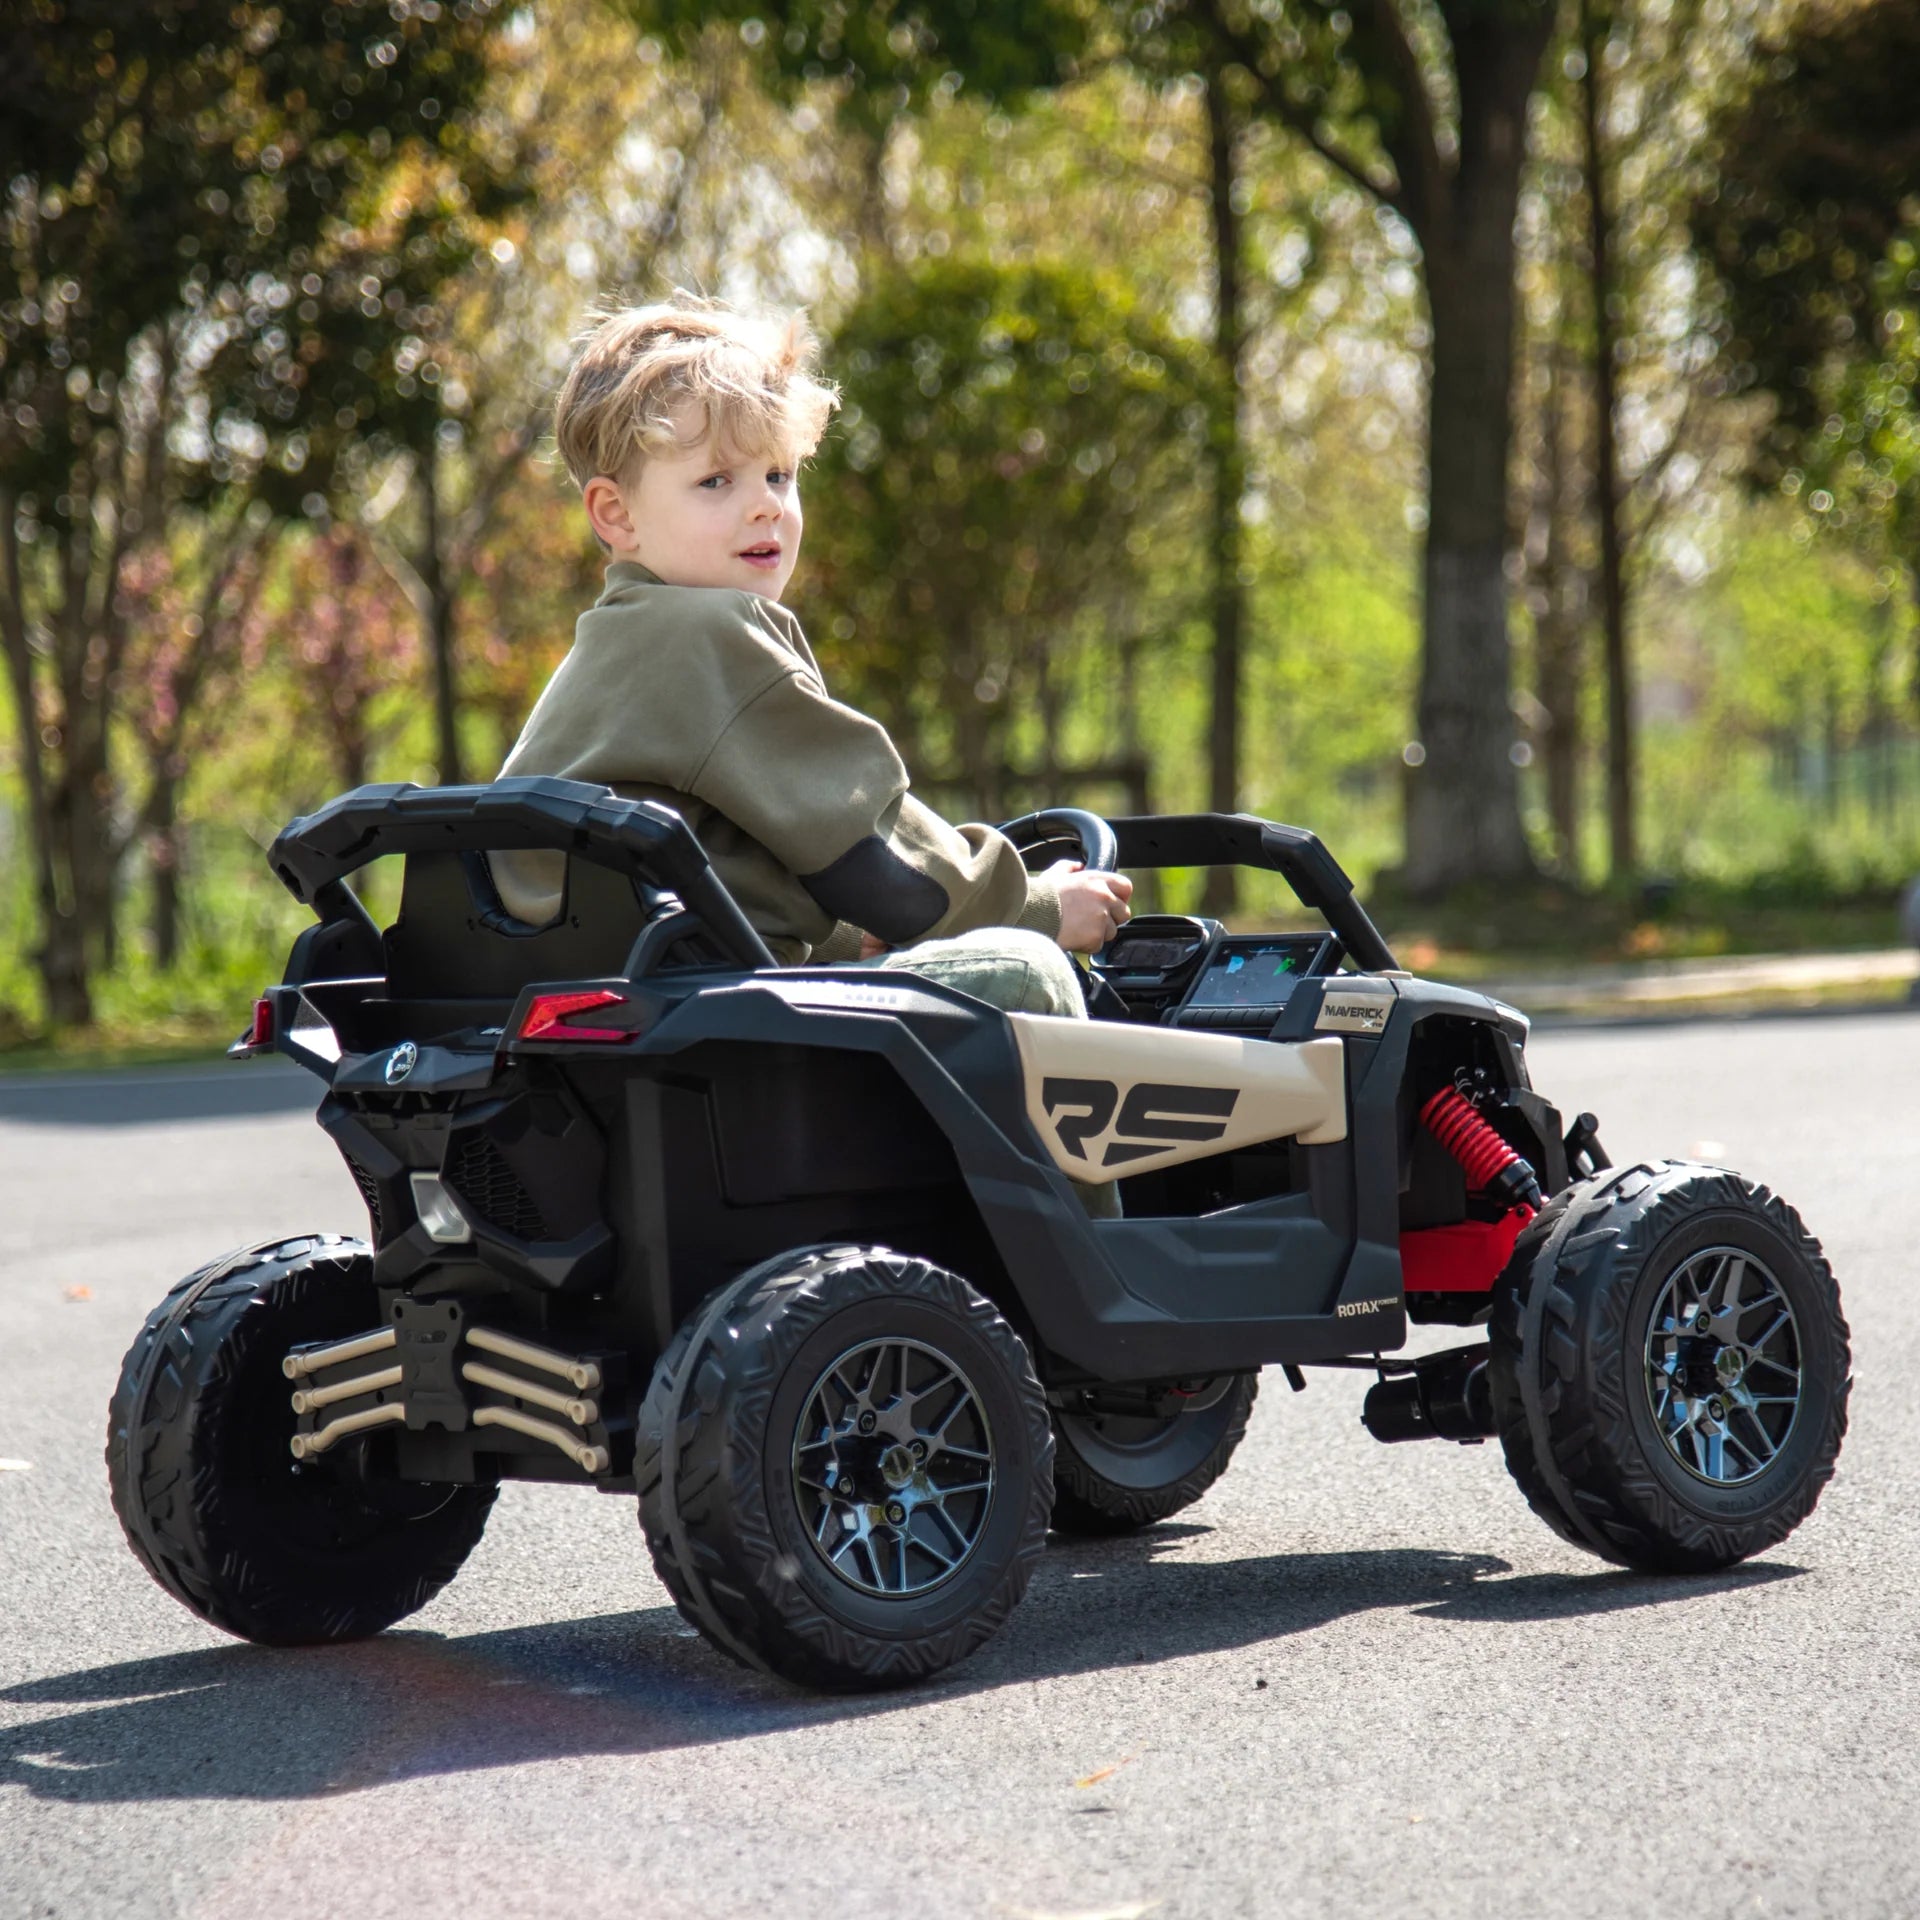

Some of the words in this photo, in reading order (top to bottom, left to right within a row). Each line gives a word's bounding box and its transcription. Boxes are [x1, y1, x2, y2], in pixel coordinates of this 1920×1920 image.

[1325, 1005, 1384, 1019] MAVERICK
[1042, 1077, 1240, 1167] RS
[1338, 1301, 1380, 1318] ROTAX
